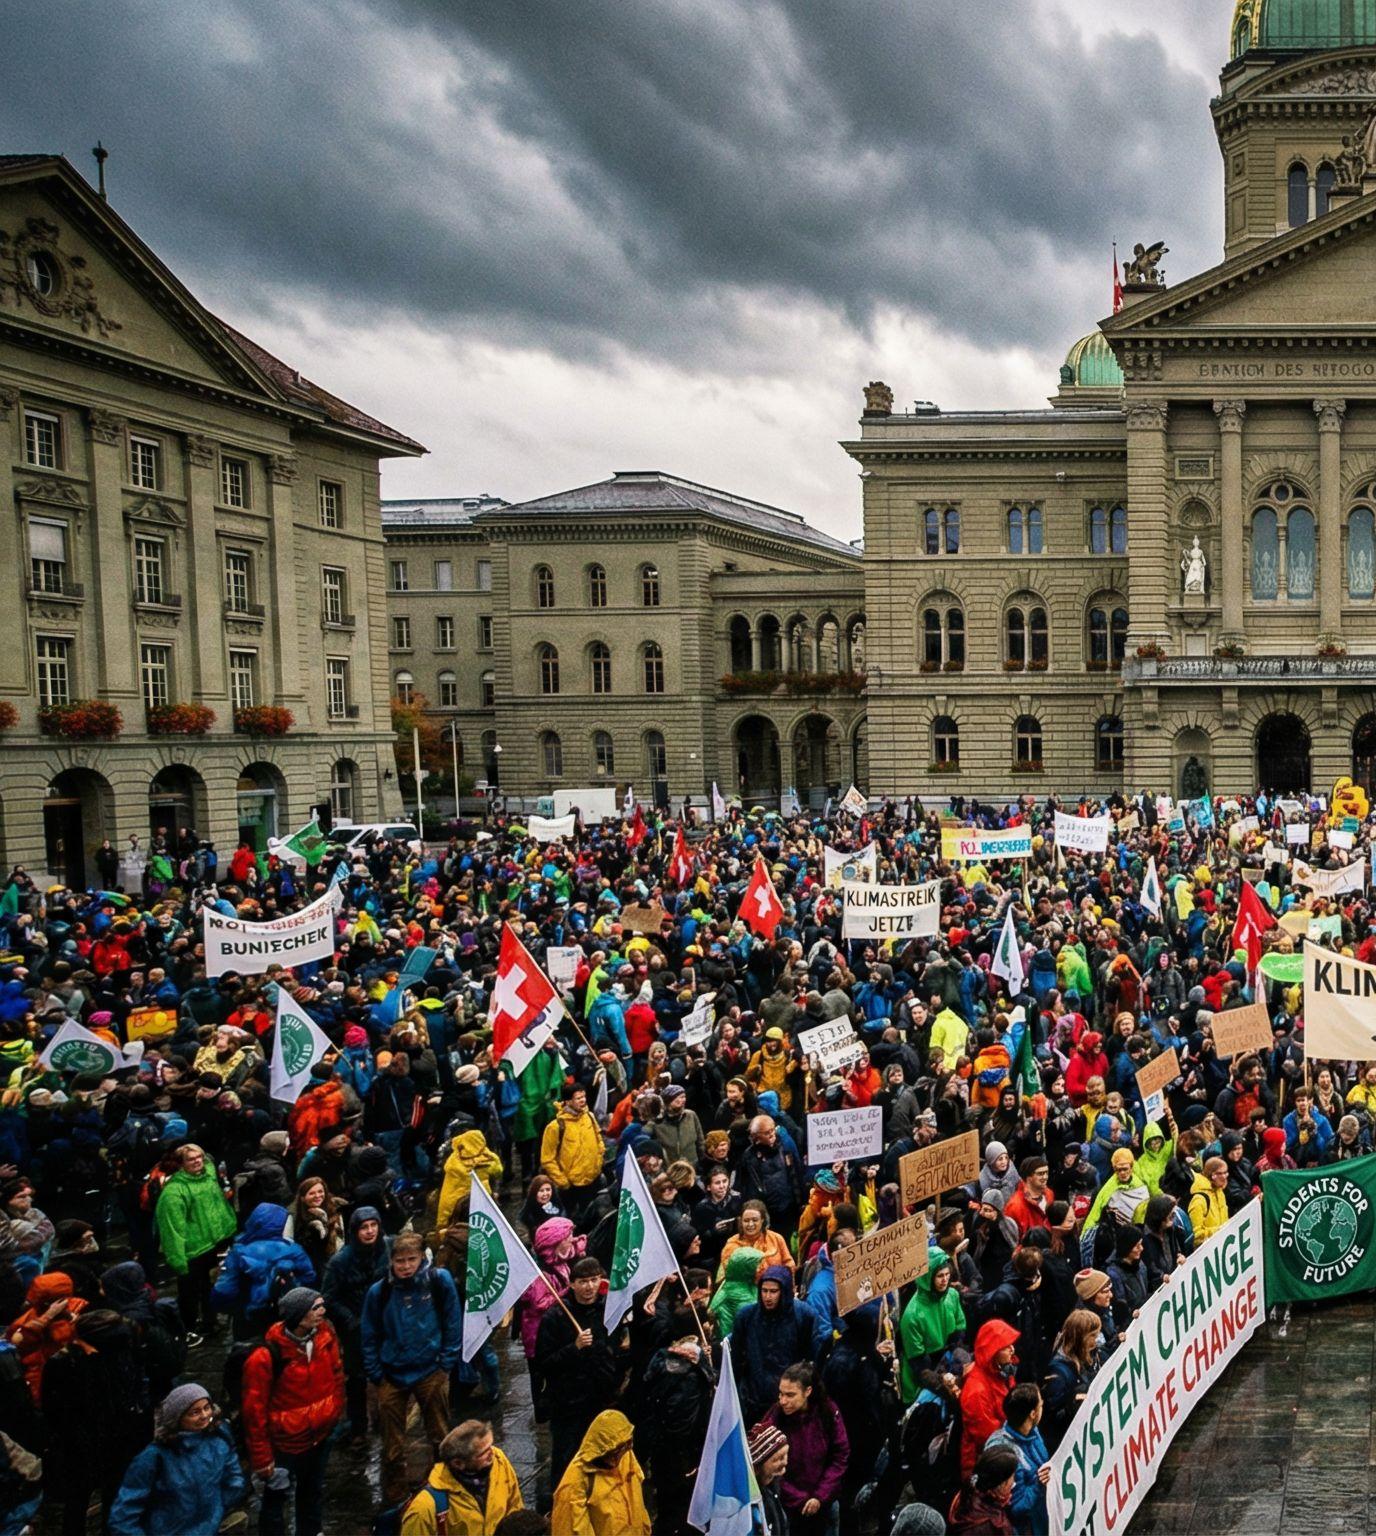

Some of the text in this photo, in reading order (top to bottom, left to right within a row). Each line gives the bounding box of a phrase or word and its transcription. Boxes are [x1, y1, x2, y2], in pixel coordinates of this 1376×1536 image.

[1275, 363, 1303, 377] DES
[847, 886, 936, 907] KLIMASTREIK
[1279, 1177, 1368, 1248] STUDENTS FOR
[1303, 1245, 1365, 1283] FUTURE
[1062, 1218, 1254, 1531] SYSTEM CHANGE
[1104, 1275, 1258, 1531] CLIMATE CHANGE
